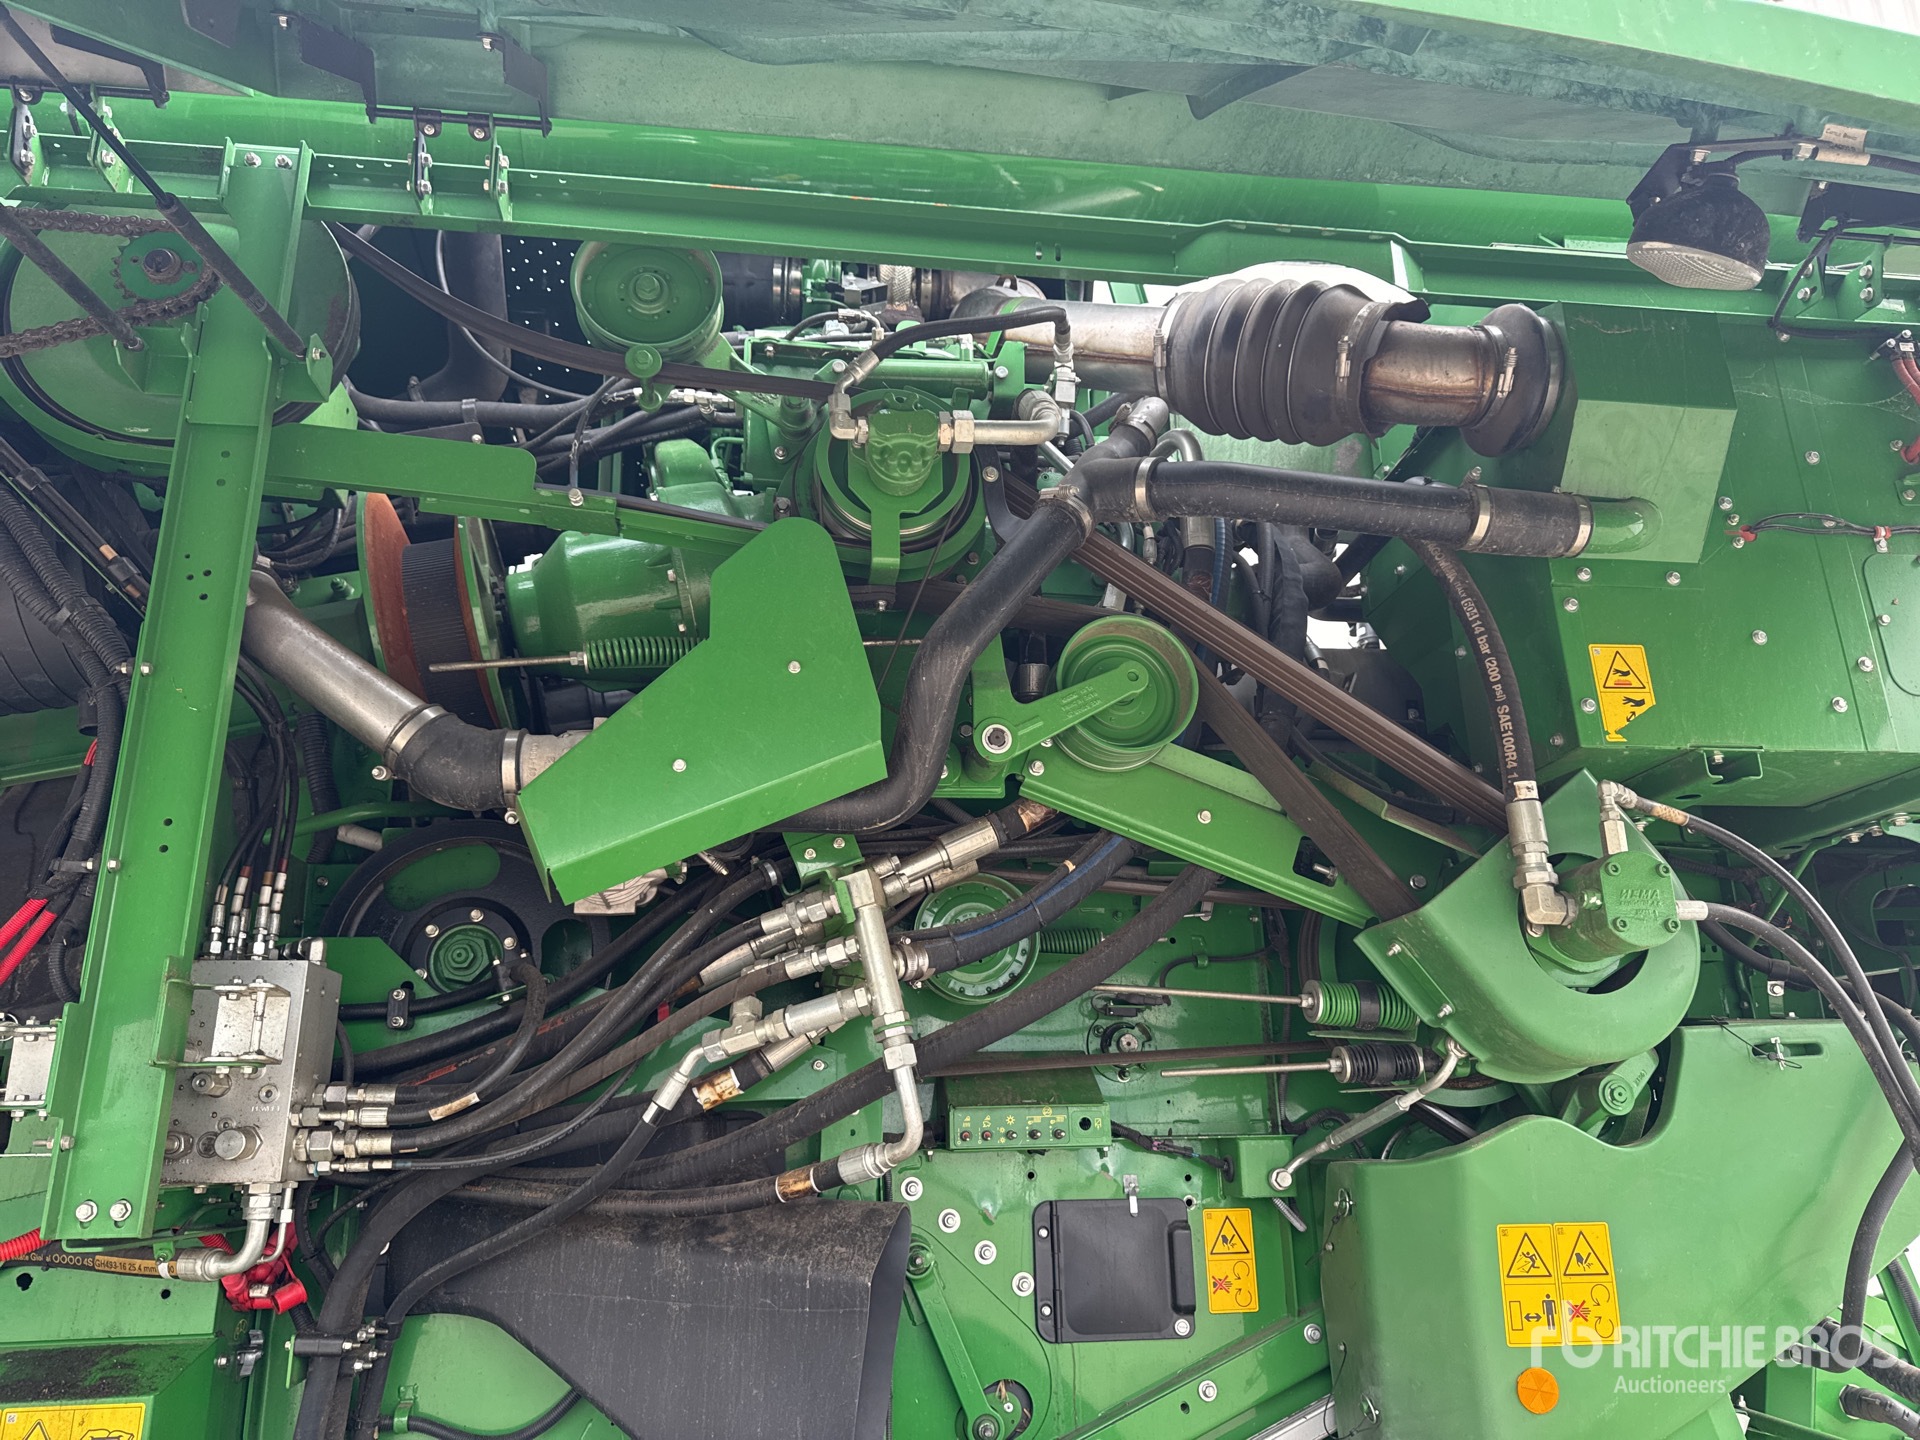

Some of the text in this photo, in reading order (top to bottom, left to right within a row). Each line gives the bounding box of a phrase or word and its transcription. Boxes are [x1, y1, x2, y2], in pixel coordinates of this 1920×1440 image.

[1453, 581, 1467, 598] ITALY
[1472, 620, 1485, 635] 14
[1476, 635, 1492, 655] bar
[1484, 657, 1502, 682] (200
[1492, 683, 1506, 702] psi)
[1497, 704, 1518, 769] SAE100R4
